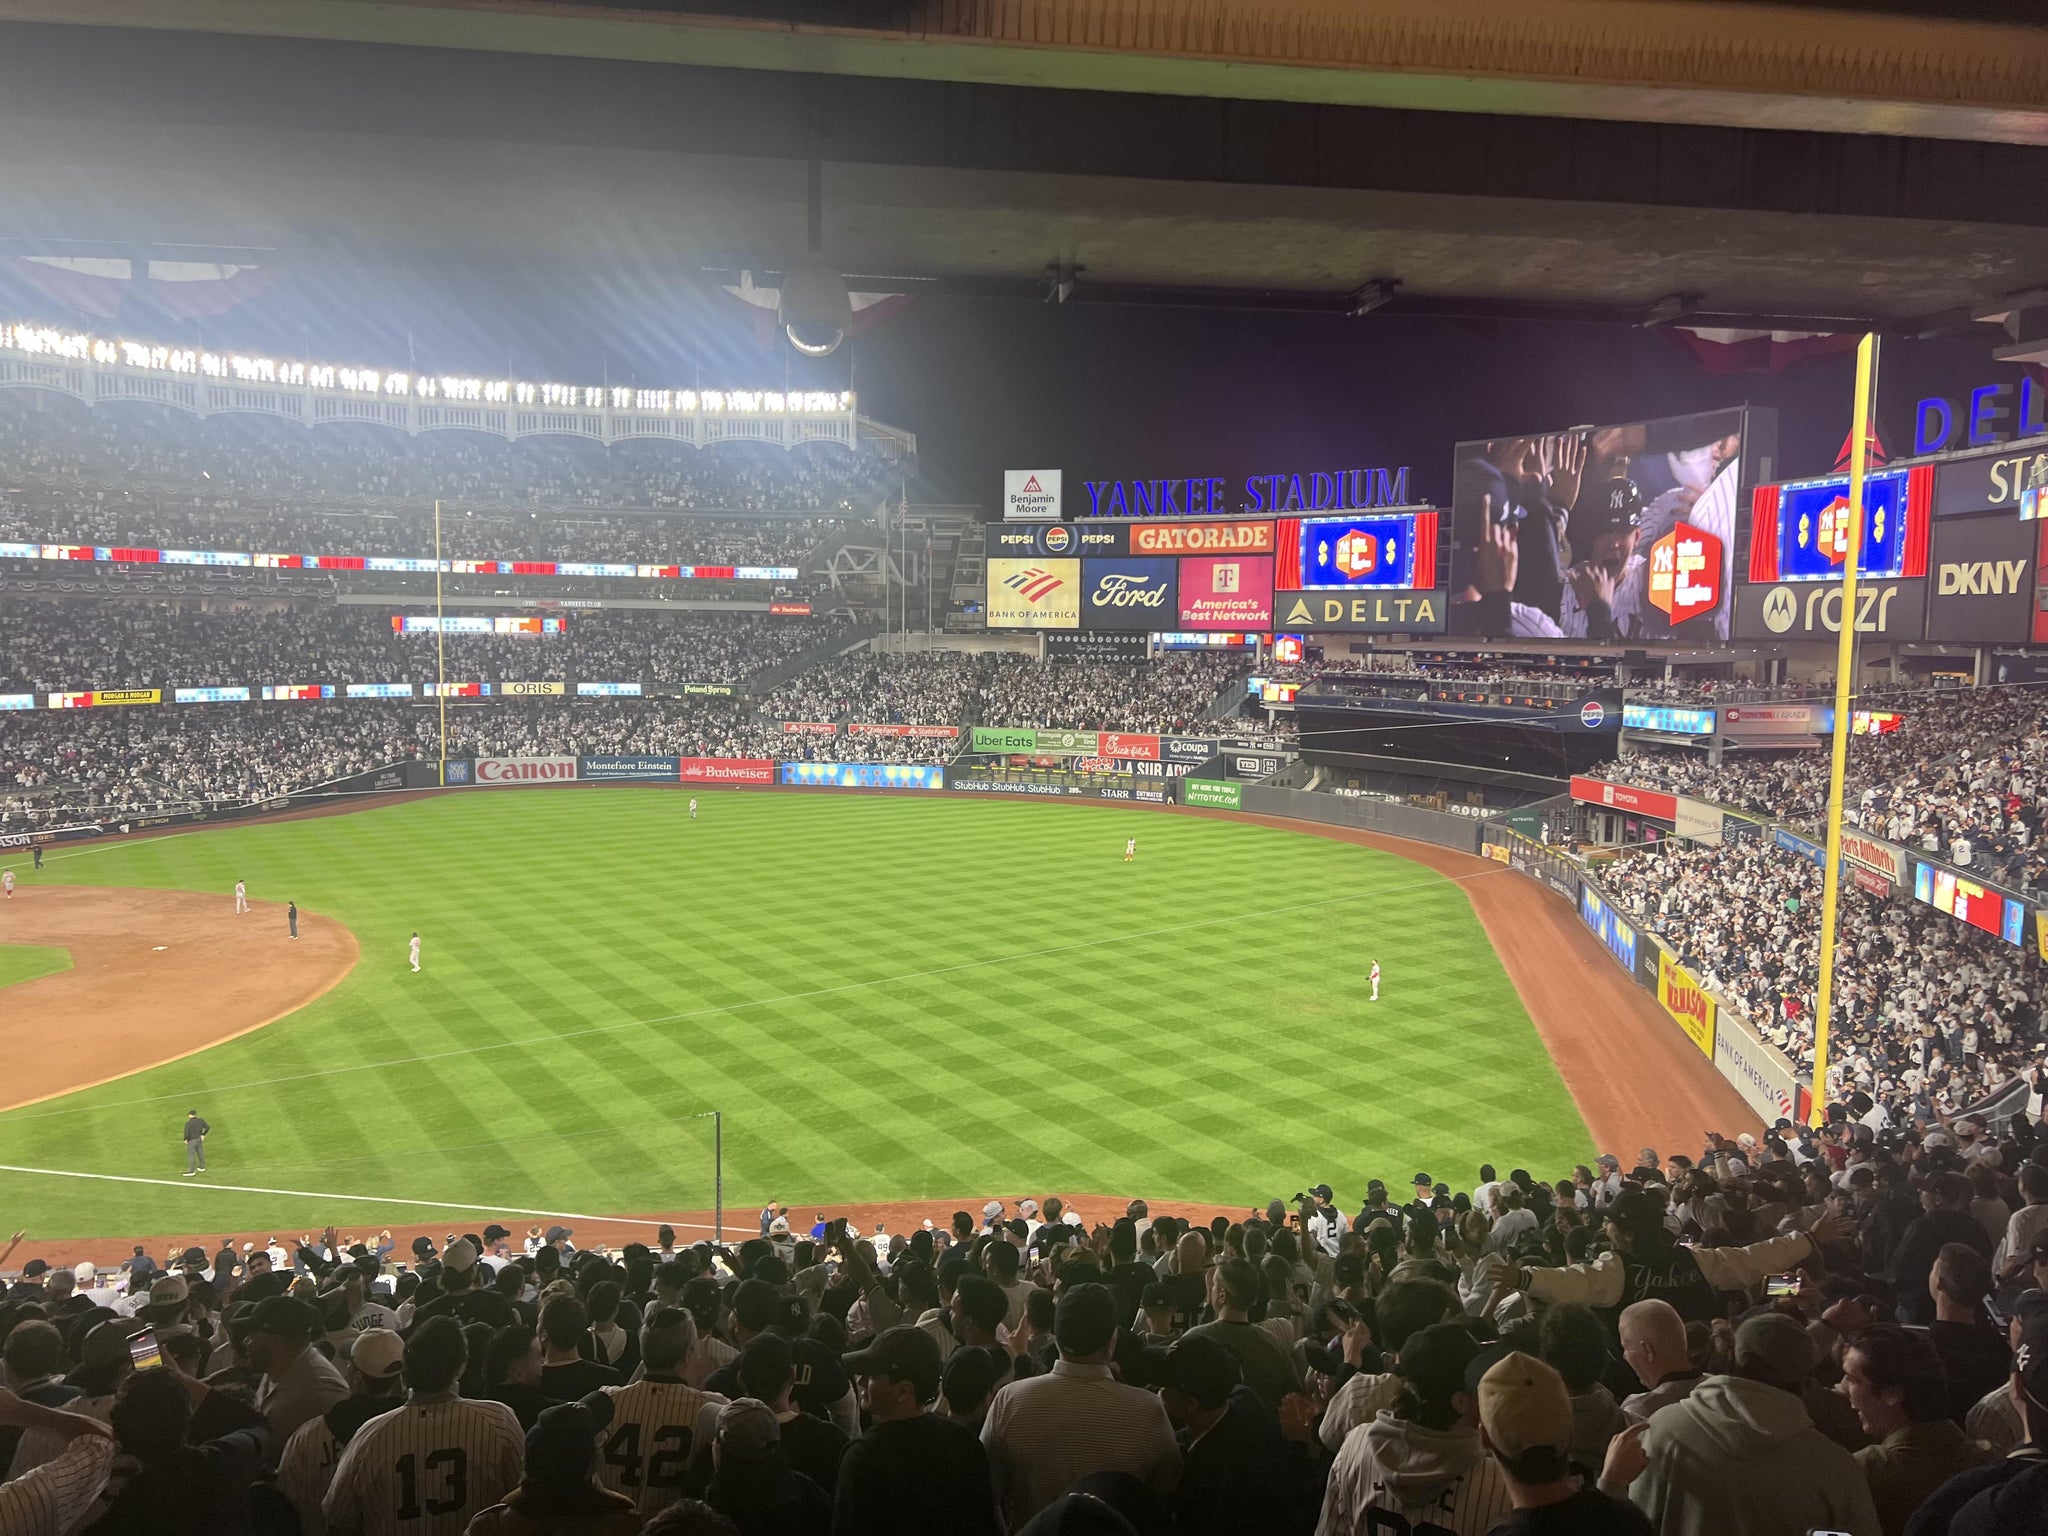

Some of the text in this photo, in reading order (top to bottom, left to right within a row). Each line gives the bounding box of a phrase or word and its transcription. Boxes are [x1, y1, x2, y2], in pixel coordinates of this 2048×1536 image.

[1083, 466, 1409, 516] YANKEE STADIUM
[1010, 494, 1055, 506] Benjamin
[1016, 504, 1047, 513] Moore
[1000, 535, 1034, 545] PEPSI
[1048, 535, 1068, 543] PEPSI
[1081, 534, 1115, 545] PEPSI
[1138, 526, 1268, 550] GATORADE
[1938, 559, 2028, 596] DKNY
[1092, 574, 1168, 607] Ford
[1192, 598, 1258, 611] America's
[1324, 599, 1436, 623] DELTA
[989, 610, 1077, 620] BANK OF AMERICA
[1182, 609, 1269, 622] Best Network
[513, 683, 552, 694] ORIS
[684, 685, 731, 696] Poland Spring
[975, 735, 1003, 746] Uber
[1005, 735, 1033, 747] Eats
[1183, 742, 1209, 754] coupa
[477, 760, 574, 781] Canon
[586, 761, 672, 770] Montefiore Einstein
[1240, 760, 1256, 769] YES
[954, 781, 1061, 795] StubHub StubHub StubHub
[1101, 788, 1129, 799] STARR
[1188, 791, 1239, 806] NITTOTIRE.COM
[1615, 792, 1638, 805] TOYOTA
[1840, 834, 1859, 857] Parts
[1859, 840, 1895, 873] Authority
[1716, 1032, 1775, 1105] BANK OF AMERICA
[1326, 1220, 1337, 1239] 2
[877, 1243, 889, 1251] 99
[271, 1256, 278, 1266] 2
[604, 1422, 693, 1489] 42
[395, 1447, 467, 1521] 13
